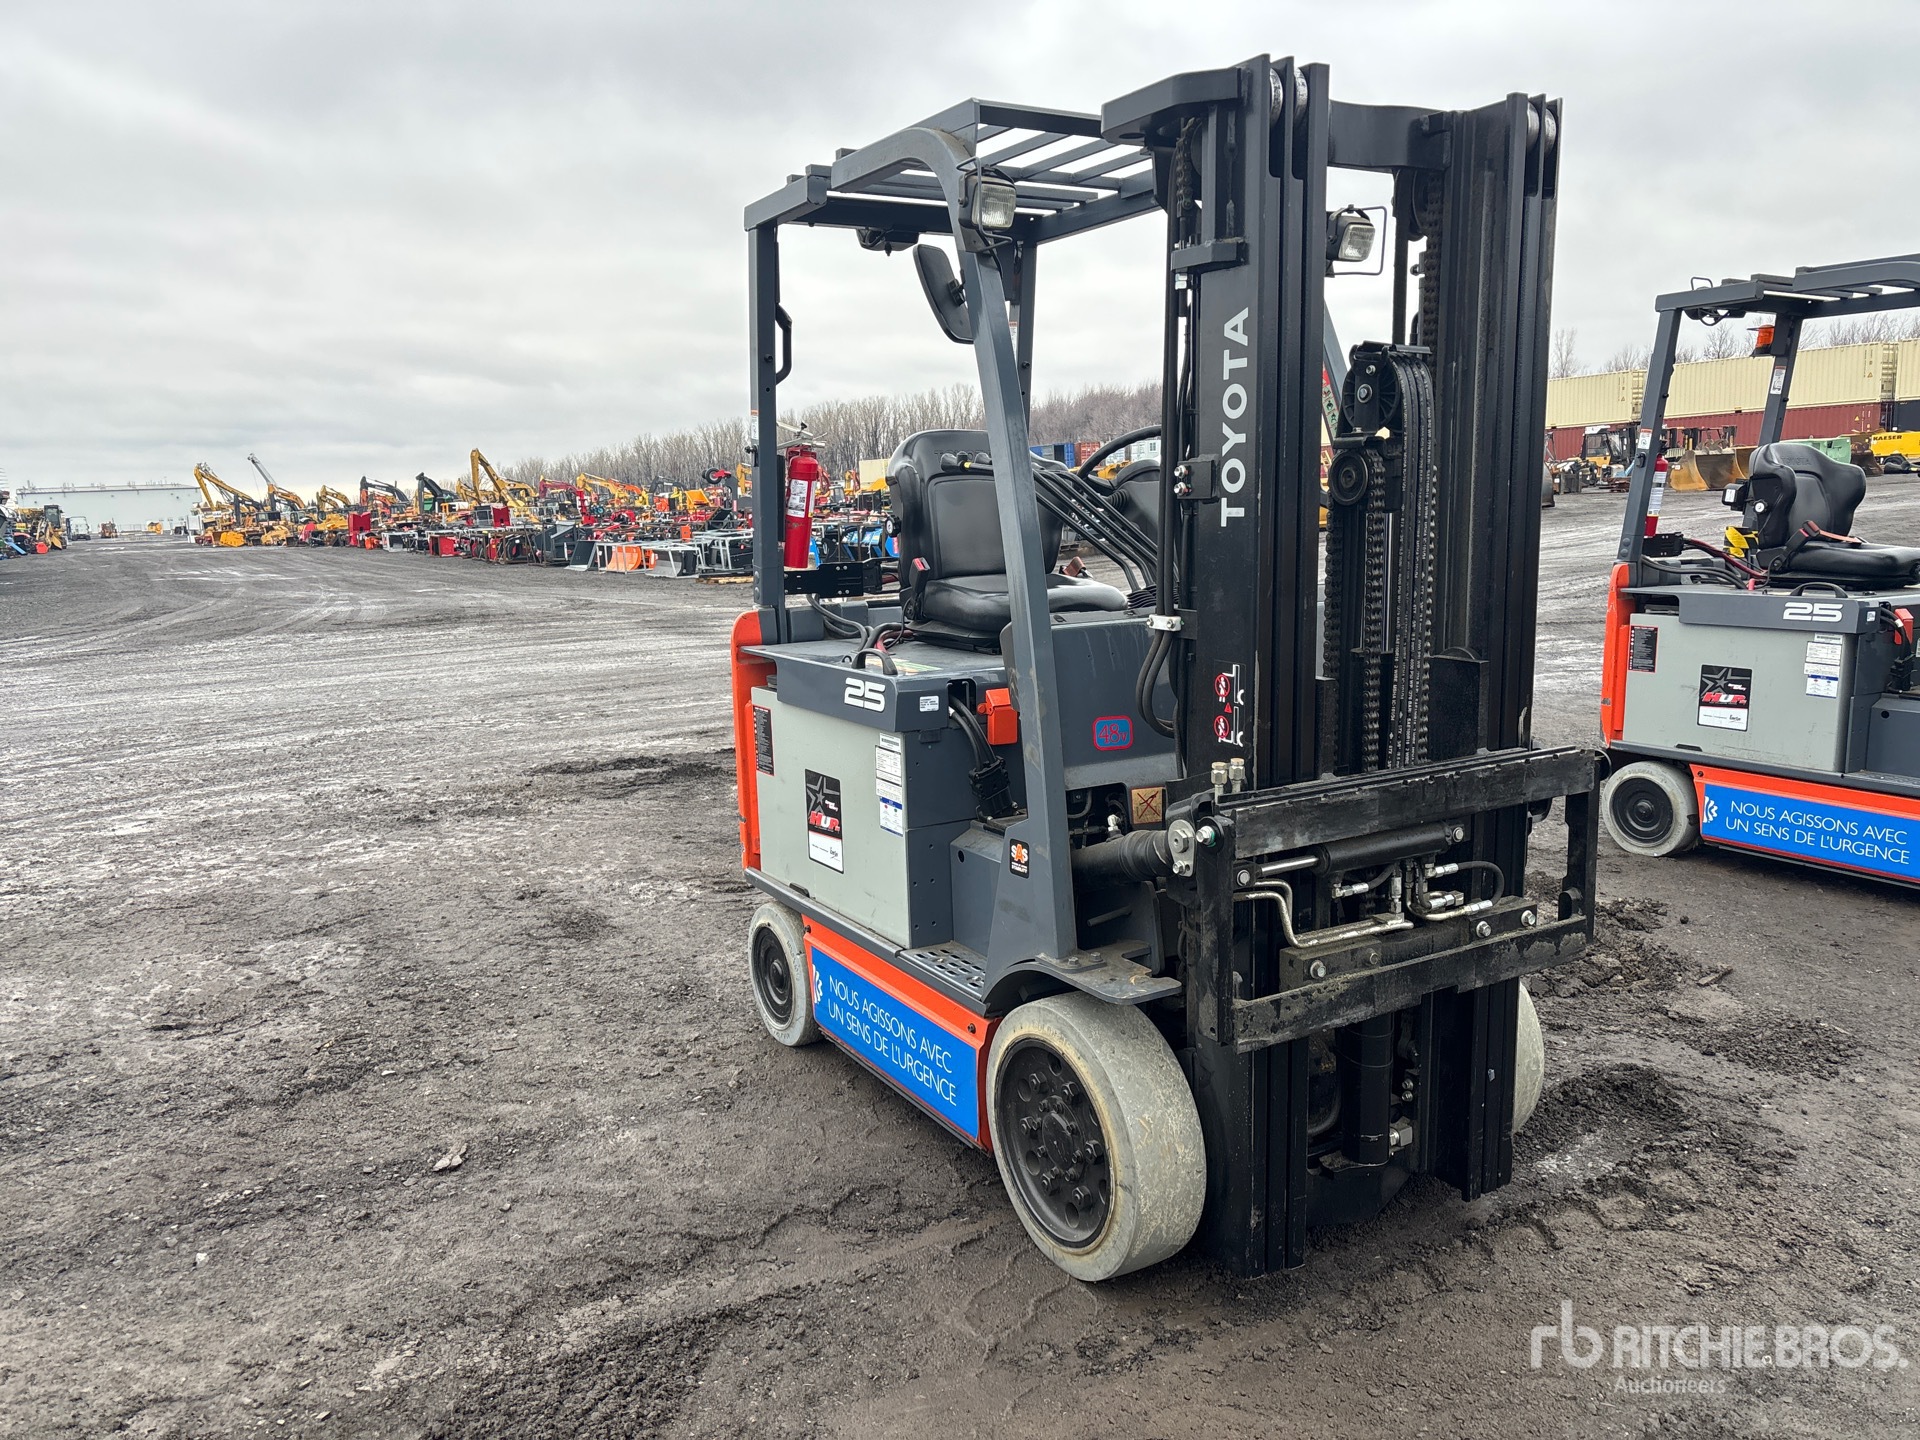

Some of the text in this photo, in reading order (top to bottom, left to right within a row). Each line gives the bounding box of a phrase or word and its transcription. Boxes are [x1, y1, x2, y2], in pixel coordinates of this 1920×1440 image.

[1220, 307, 1249, 527] TOYOTA
[1782, 602, 1844, 622] 25
[844, 677, 886, 713] 25
[1725, 817, 1911, 865] UN SENS DE L'URGENCE
[1730, 800, 1908, 845] NOUS AGISSONS AVEC
[1011, 843, 1029, 864] SAS
[829, 975, 953, 1074] NOUS AGISSONS AVEC
[828, 998, 957, 1106] UN SENS DE L'URGENCE
